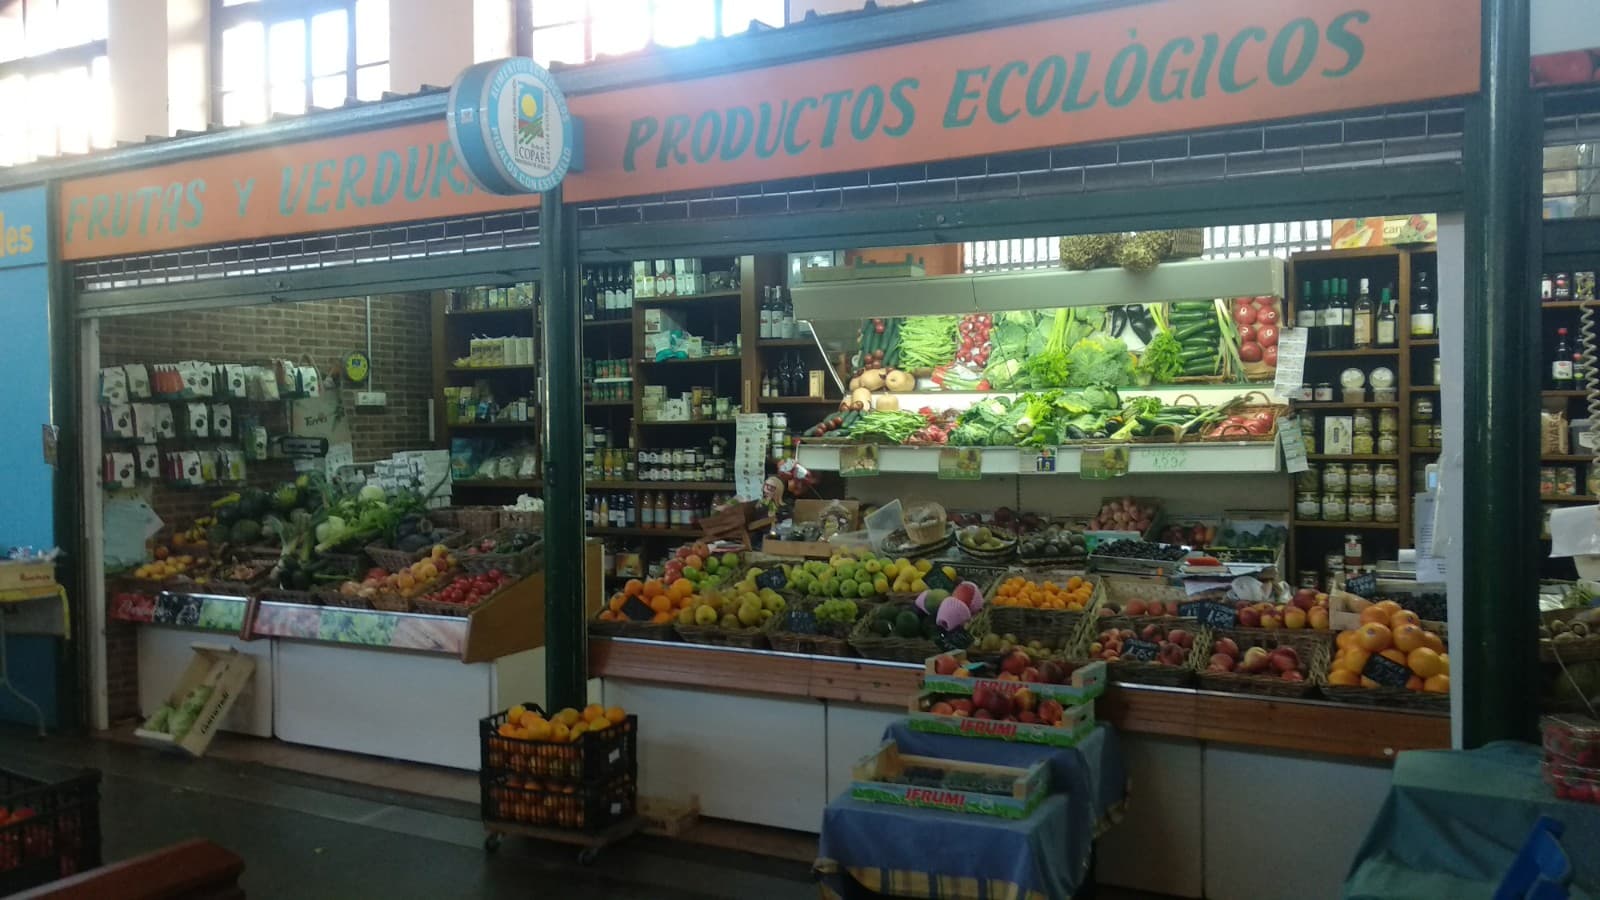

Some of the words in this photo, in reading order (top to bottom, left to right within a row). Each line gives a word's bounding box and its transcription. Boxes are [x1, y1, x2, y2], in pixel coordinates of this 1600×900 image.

[623, 77, 919, 173] PRODUCTOS
[519, 145, 545, 165] COPAE
[65, 178, 207, 244] FRUTAS
[234, 177, 256, 218] Y
[278, 139, 474, 217] VERDUR
[959, 718, 1018, 738] IFRUMI
[904, 787, 966, 807] IFRUMI
